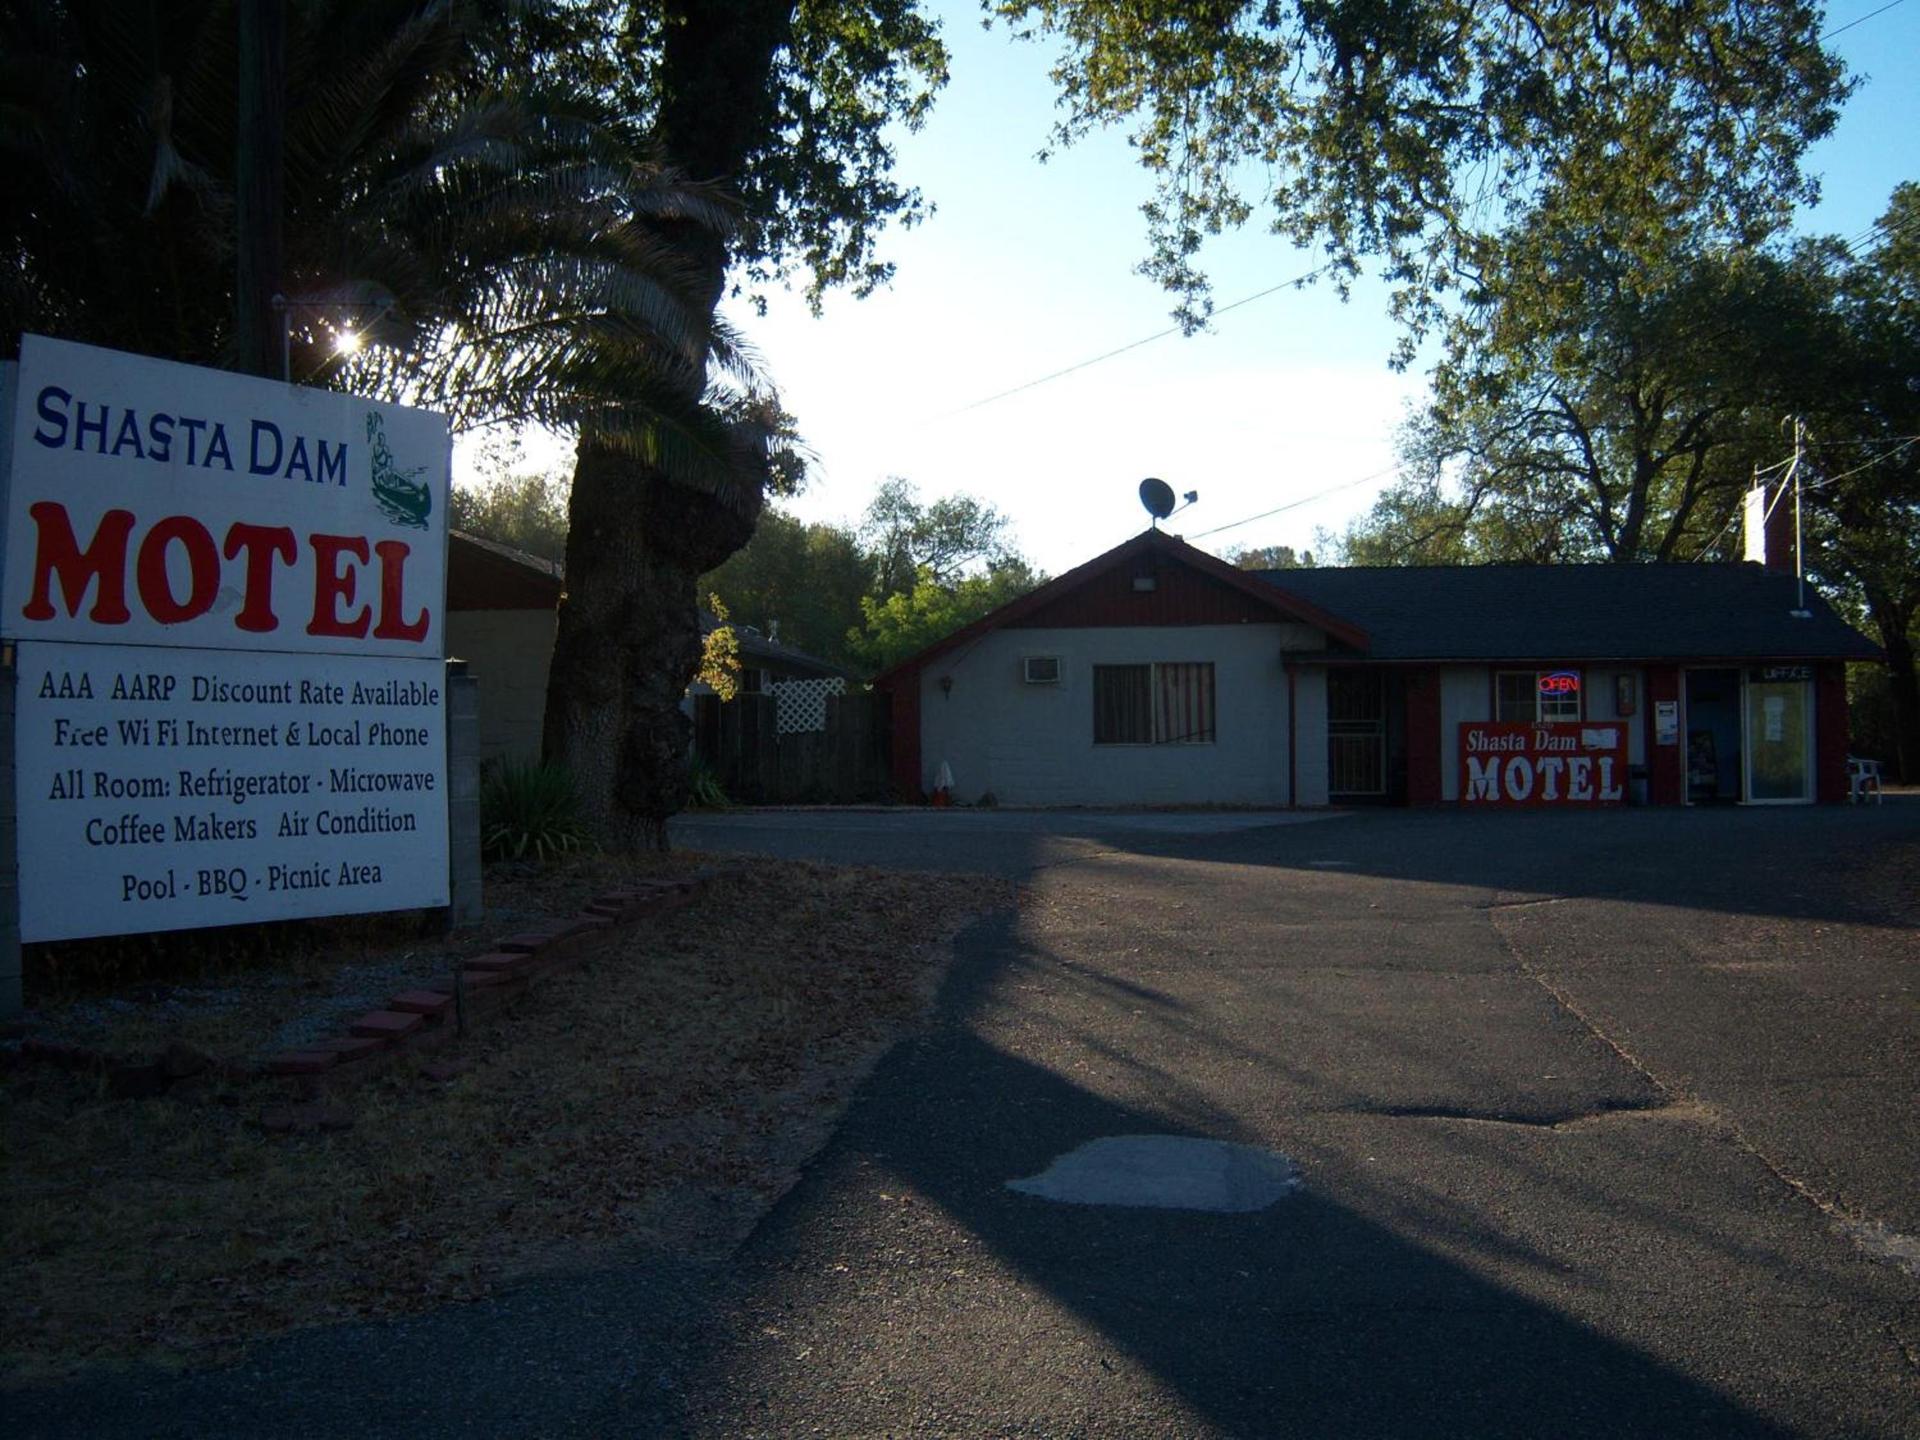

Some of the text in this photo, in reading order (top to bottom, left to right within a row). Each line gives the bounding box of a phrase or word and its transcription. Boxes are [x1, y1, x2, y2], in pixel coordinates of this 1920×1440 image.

[34, 386, 347, 487] SHASTA DAM
[22, 501, 429, 643] MOTEL
[38, 671, 439, 706] AAA AARP Discount Rate Available
[1538, 675, 1579, 692] OPEN
[54, 719, 108, 746] Free
[187, 720, 278, 746] Internet
[286, 721, 300, 746] &
[308, 720, 360, 746] Local
[368, 723, 429, 746] Phone
[1466, 729, 1577, 752] Shasta Dam
[49, 769, 84, 799] All
[94, 772, 170, 798] Room:
[179, 768, 311, 804] Refrigerator
[330, 767, 435, 793] Microwave
[1465, 756, 1623, 801] MOTEL
[86, 807, 416, 845] Coffee Makers Air Condition
[122, 869, 176, 901] Pool
[198, 868, 248, 901] BBQ
[268, 862, 330, 891] Picnic
[338, 861, 382, 886] Area
